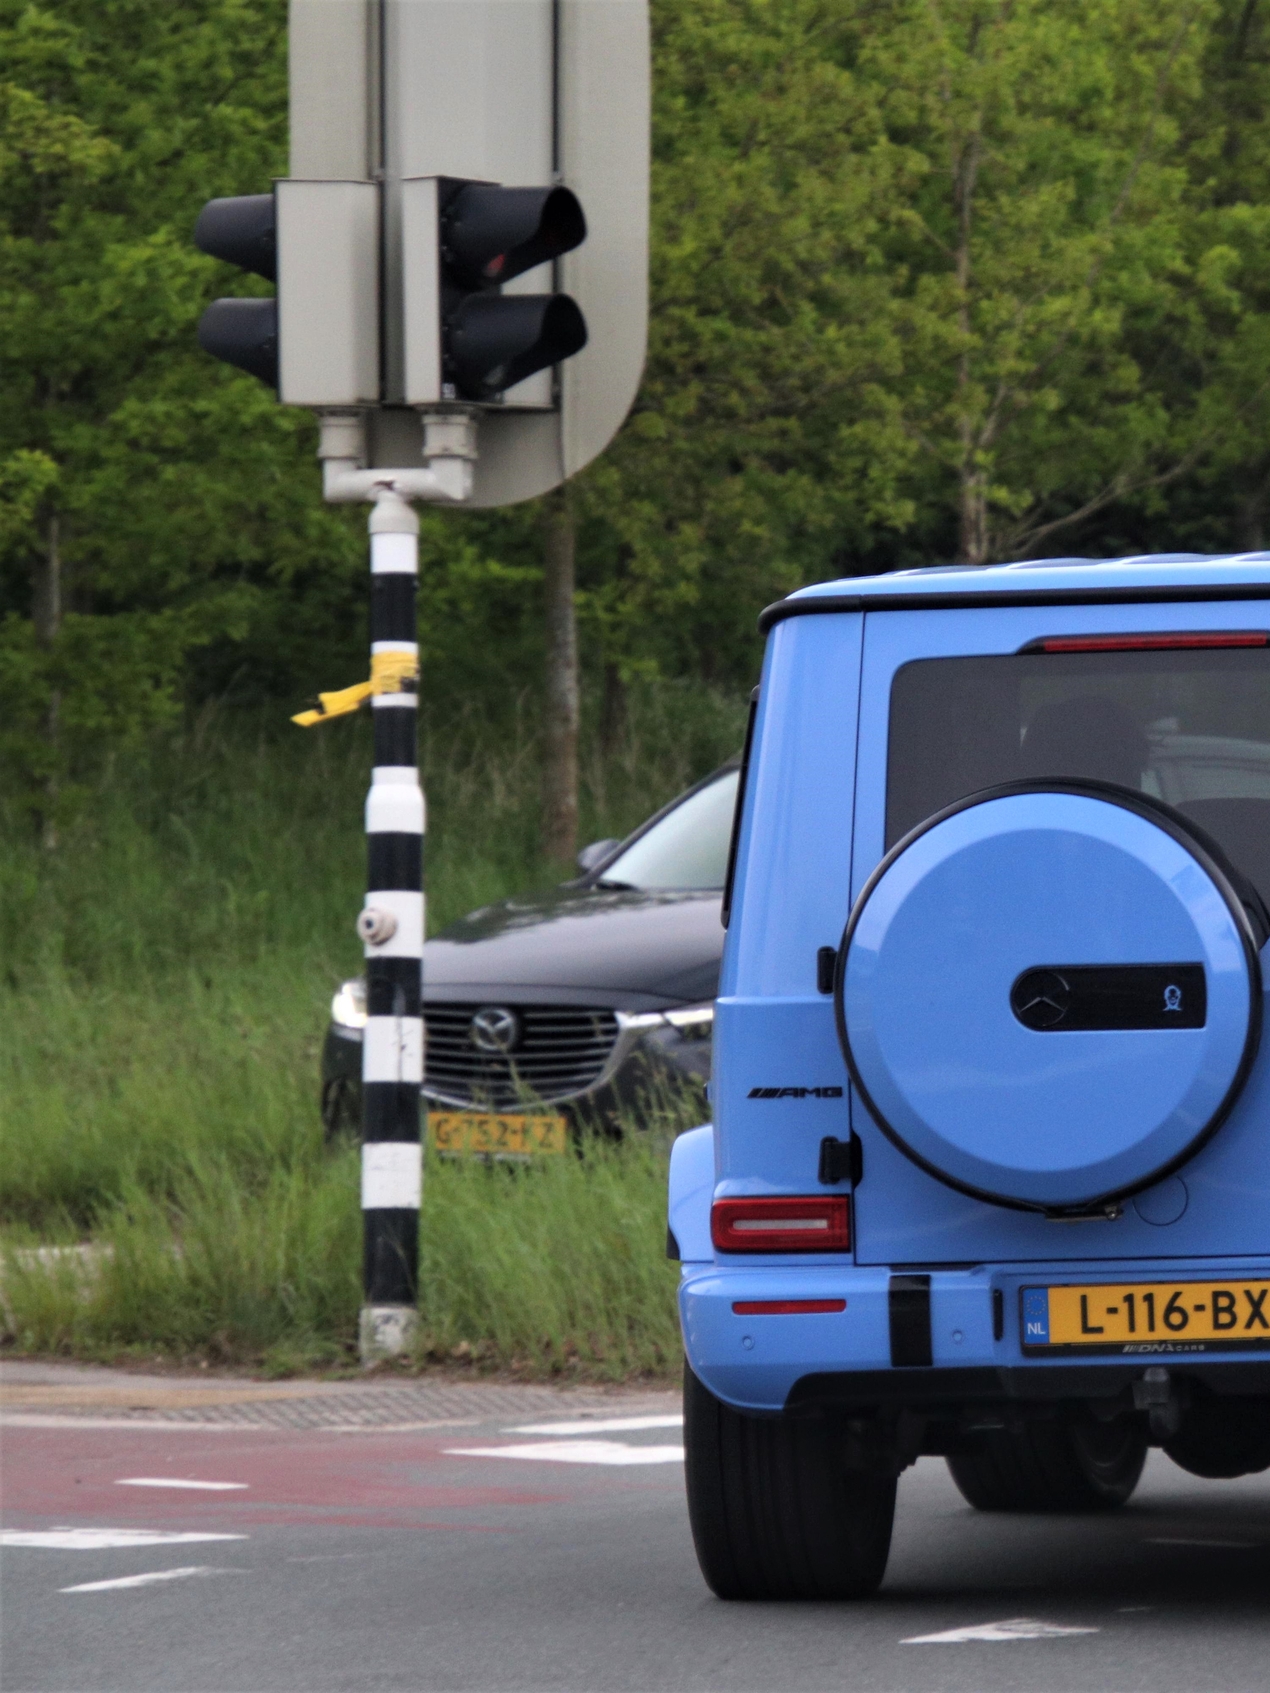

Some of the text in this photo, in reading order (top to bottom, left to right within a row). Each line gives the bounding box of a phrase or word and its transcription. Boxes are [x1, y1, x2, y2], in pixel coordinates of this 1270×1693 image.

[776, 1086, 843, 1098] AMG
[1080, 1289, 1270, 1334] L-116-BX
[1027, 1322, 1046, 1335] NL
